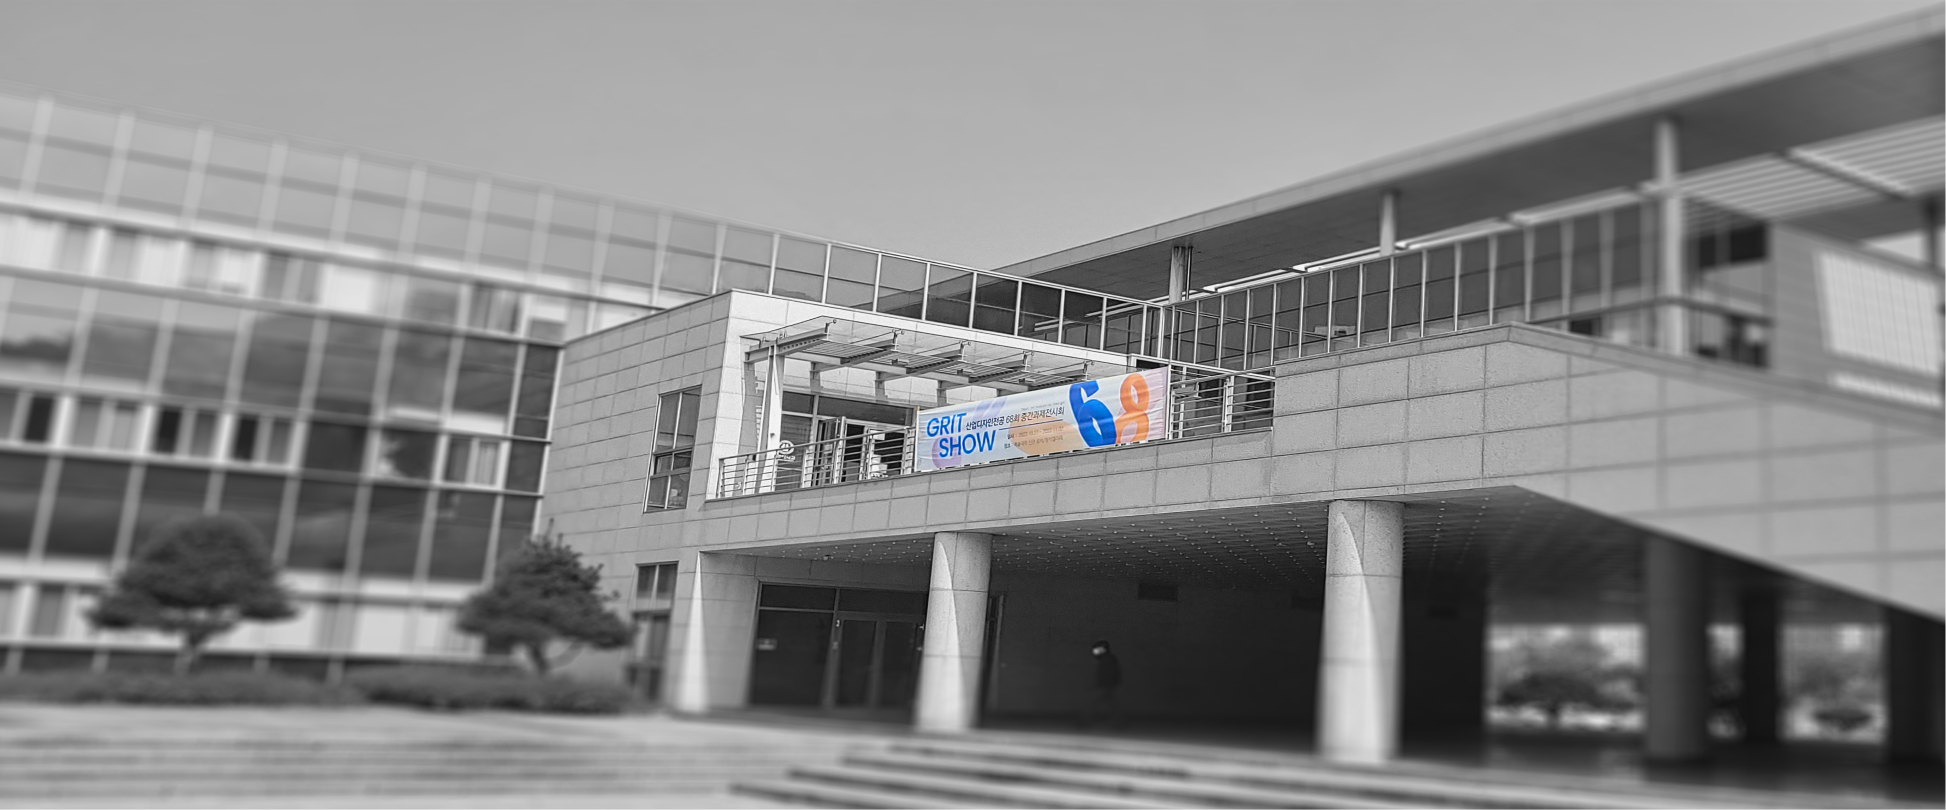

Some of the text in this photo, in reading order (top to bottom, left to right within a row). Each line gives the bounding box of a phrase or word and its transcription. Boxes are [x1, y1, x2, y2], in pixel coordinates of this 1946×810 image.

[965, 406, 1065, 431] 산업디자인전공 68회 중간과제전시회
[1069, 373, 1150, 447] 68
[926, 412, 968, 438] GRIT
[939, 429, 997, 458] SHOW
